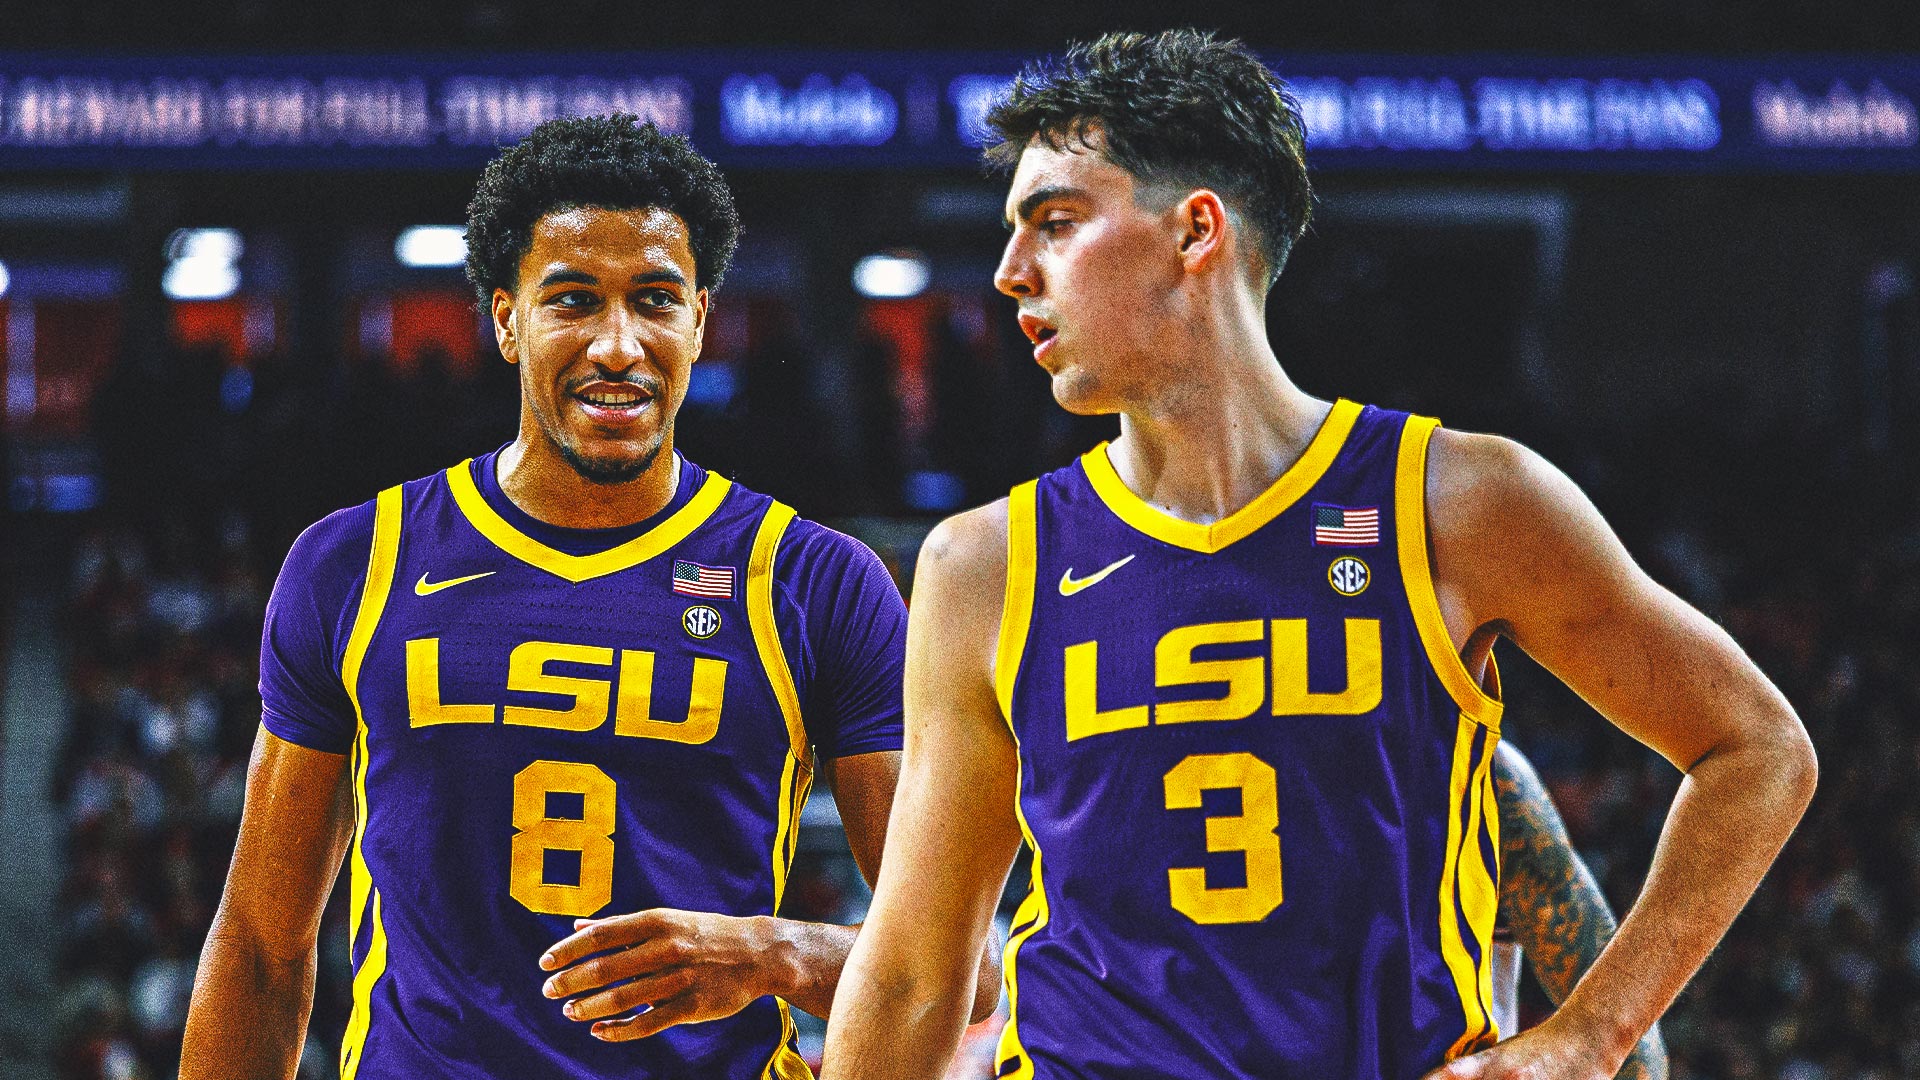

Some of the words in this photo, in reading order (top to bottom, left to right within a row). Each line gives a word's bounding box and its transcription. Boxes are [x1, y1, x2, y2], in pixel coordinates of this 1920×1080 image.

[687, 607, 718, 636] SEC
[1332, 559, 1366, 592] SEC
[405, 638, 728, 744] LSU
[1064, 618, 1382, 742] LSU
[510, 760, 617, 917] 8
[1163, 752, 1283, 925] 3
